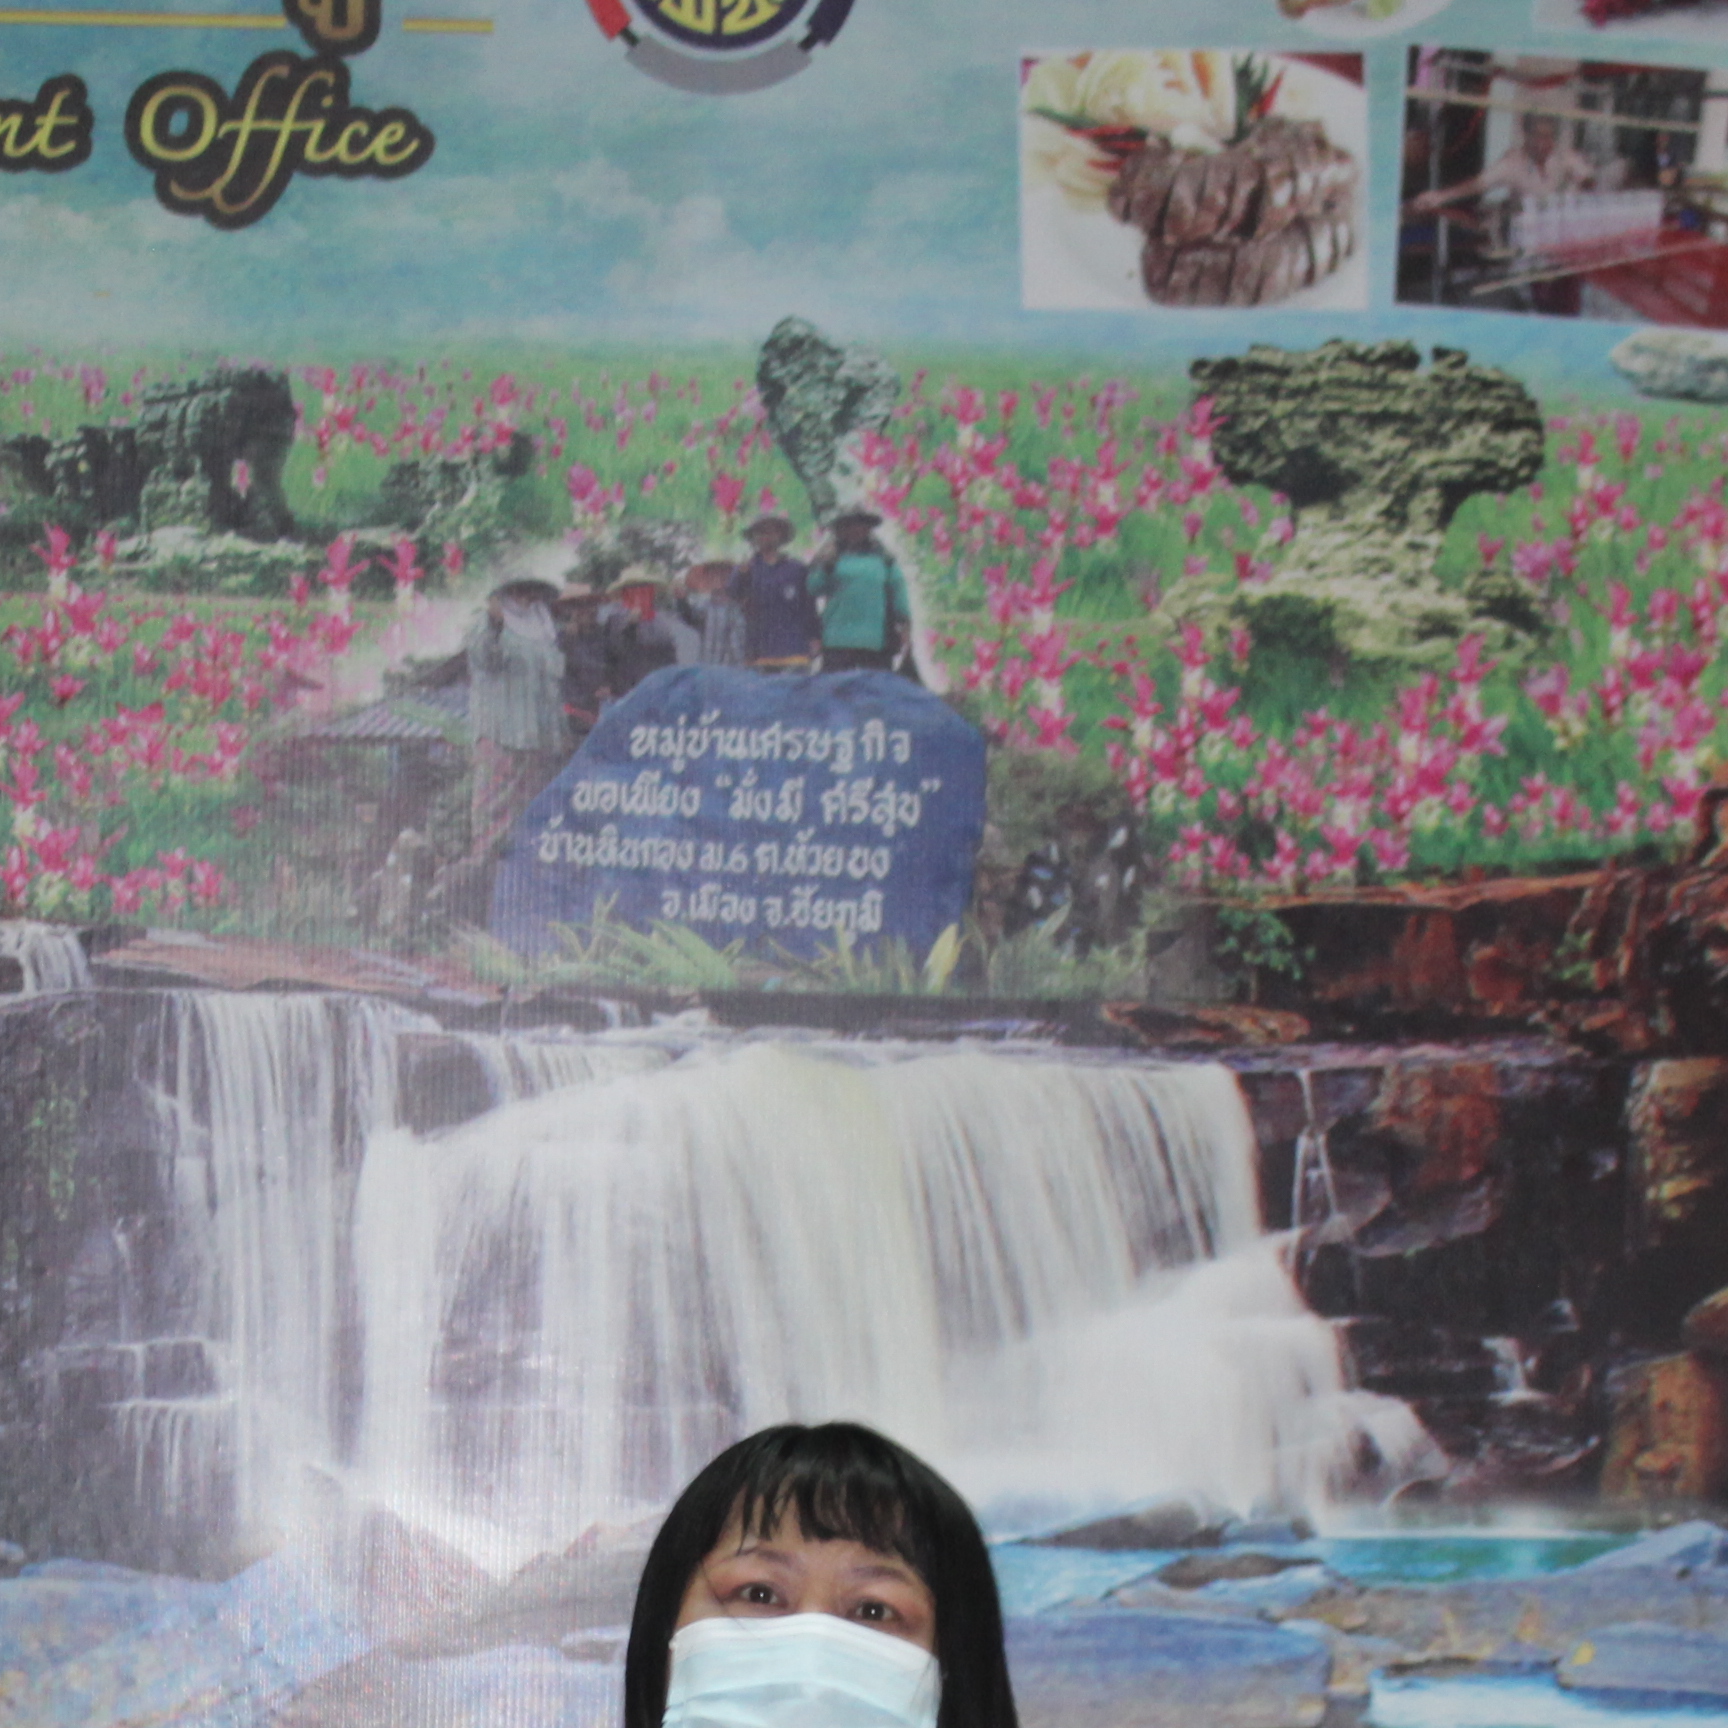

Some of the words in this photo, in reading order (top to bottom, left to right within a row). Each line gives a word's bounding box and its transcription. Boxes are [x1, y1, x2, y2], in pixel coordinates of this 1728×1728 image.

[139, 62, 419, 205] Office
[573, 769, 702, 818] พอเพียง
